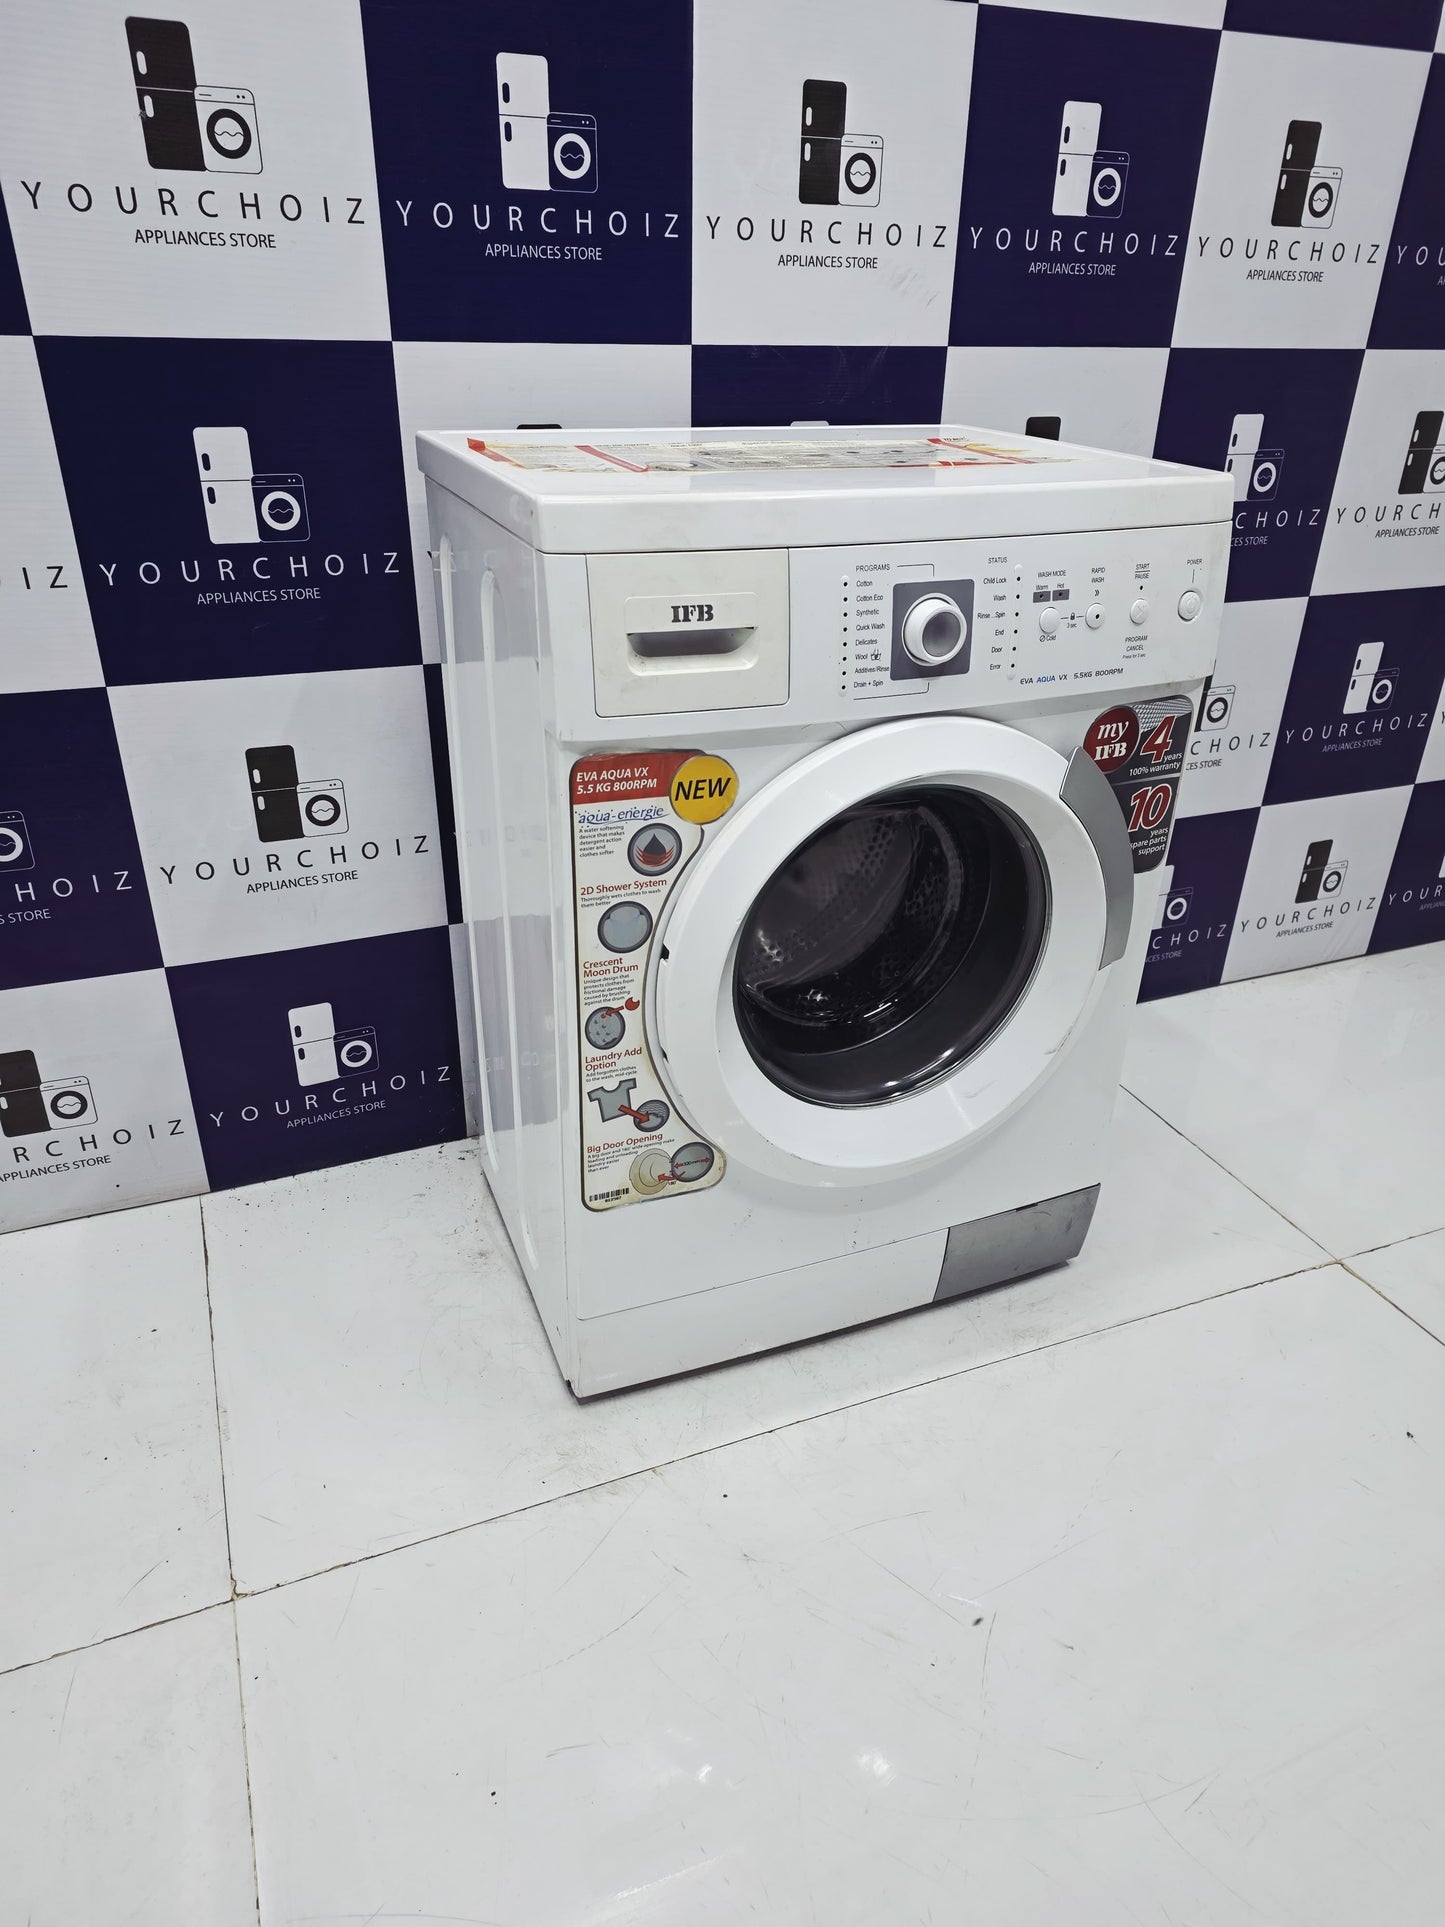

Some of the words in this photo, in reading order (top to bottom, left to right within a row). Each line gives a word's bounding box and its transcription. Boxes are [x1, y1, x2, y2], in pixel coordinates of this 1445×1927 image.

[20, 180, 366, 226] YOURCHOIZ
[395, 200, 680, 239] YOURCHOIZ
[134, 228, 226, 248] APPLIANCES
[229, 231, 277, 249] STORE
[706, 215, 948, 249] YOURCHOIZ
[970, 226, 1178, 257] YOURCHOIZ
[485, 242, 561, 260] APPLIANCES
[563, 246, 603, 261] STORE
[1198, 236, 1381, 265] YOURCHOIZ
[777, 254, 843, 269] APPLIANCES
[846, 255, 879, 269] STORE
[1028, 261, 1086, 276] APPLIANCES
[1088, 262, 1117, 277] STORE
[1246, 269, 1297, 282] APPLIANCES
[1297, 270, 1325, 283] STORE
[1375, 527, 1417, 538] APPLIANCES
[1417, 525, 1441, 536] STORE
[1244, 535, 1269, 546] STORE
[855, 563, 891, 572] PROGRAMS
[988, 556, 1008, 564] STATUS
[1135, 563, 1150, 571] START
[1186, 558, 1203, 566] POWER
[99, 552, 400, 587] YOURCHOIZ
[856, 579, 873, 587] Cotton
[983, 577, 996, 585] Child
[996, 576, 1007, 584] Lock
[197, 589, 278, 605] APPLIANCES
[280, 587, 321, 603] STORE
[993, 594, 1007, 602] Wash
[671, 604, 714, 623] IFB
[855, 608, 880, 617] Synthetic
[855, 623, 870, 632] Quick
[870, 622, 886, 630] Wash
[994, 629, 1005, 637] End
[855, 638, 878, 646] Delicates
[1046, 634, 1057, 642] Cold
[1124, 634, 1149, 644] PROGRAM
[1126, 644, 1144, 652] CANCEL
[853, 680, 868, 688] Drain
[872, 679, 884, 688] Spin
[1036, 675, 1056, 684] AQUA
[1073, 671, 1093, 680] 5.5KG
[1094, 667, 1124, 677] 800RPM
[1097, 720, 1129, 743] my
[1285, 713, 1428, 745] YOURCHOIZ
[1140, 715, 1177, 764] 4
[1322, 740, 1360, 753] APPLIANCES
[1360, 737, 1384, 749] STORE
[1094, 742, 1128, 761] IFB
[1163, 752, 1183, 763] years
[1129, 767, 1149, 777] 100%
[1149, 761, 1181, 773] warranty
[1199, 758, 1223, 770] STORE
[576, 771, 598, 782] EVA
[600, 768, 631, 781] AQUA
[634, 766, 650, 777] VX
[576, 784, 594, 795] 5.5
[595, 782, 611, 793] KG
[613, 778, 658, 792] 800RPM
[674, 777, 732, 802] NEW
[1128, 783, 1173, 832] 10
[1150, 827, 1169, 838] years
[1130, 839, 1149, 850] spare
[1149, 835, 1167, 847] parts
[1138, 843, 1166, 855] support
[160, 835, 430, 885] YOURCHOIZ
[246, 875, 320, 894] APPLIANCES
[321, 869, 359, 886] STORE
[581, 886, 594, 896] 2D
[596, 883, 632, 894] Shower
[633, 879, 667, 891] System
[7, 908, 52, 924] STORE
[1241, 896, 1377, 933] YOURCHOIZ
[1276, 923, 1314, 938] APPLIANCES
[1313, 920, 1334, 933] STORE
[583, 957, 624, 969] Crescent
[1161, 949, 1183, 961] STORE
[584, 968, 611, 978] Moon
[613, 964, 639, 974] Drum
[585, 1051, 623, 1064] Laundry
[623, 1046, 643, 1057] Add
[585, 1061, 617, 1072] Option
[210, 1065, 452, 1129] YOURCHOIZ
[286, 1106, 352, 1129] APPLIANCES
[352, 1099, 387, 1117] STORE
[587, 1145, 601, 1153] Big
[602, 1140, 625, 1151] Door
[625, 1133, 664, 1146] Opening
[72, 1154, 112, 1170] STORE
